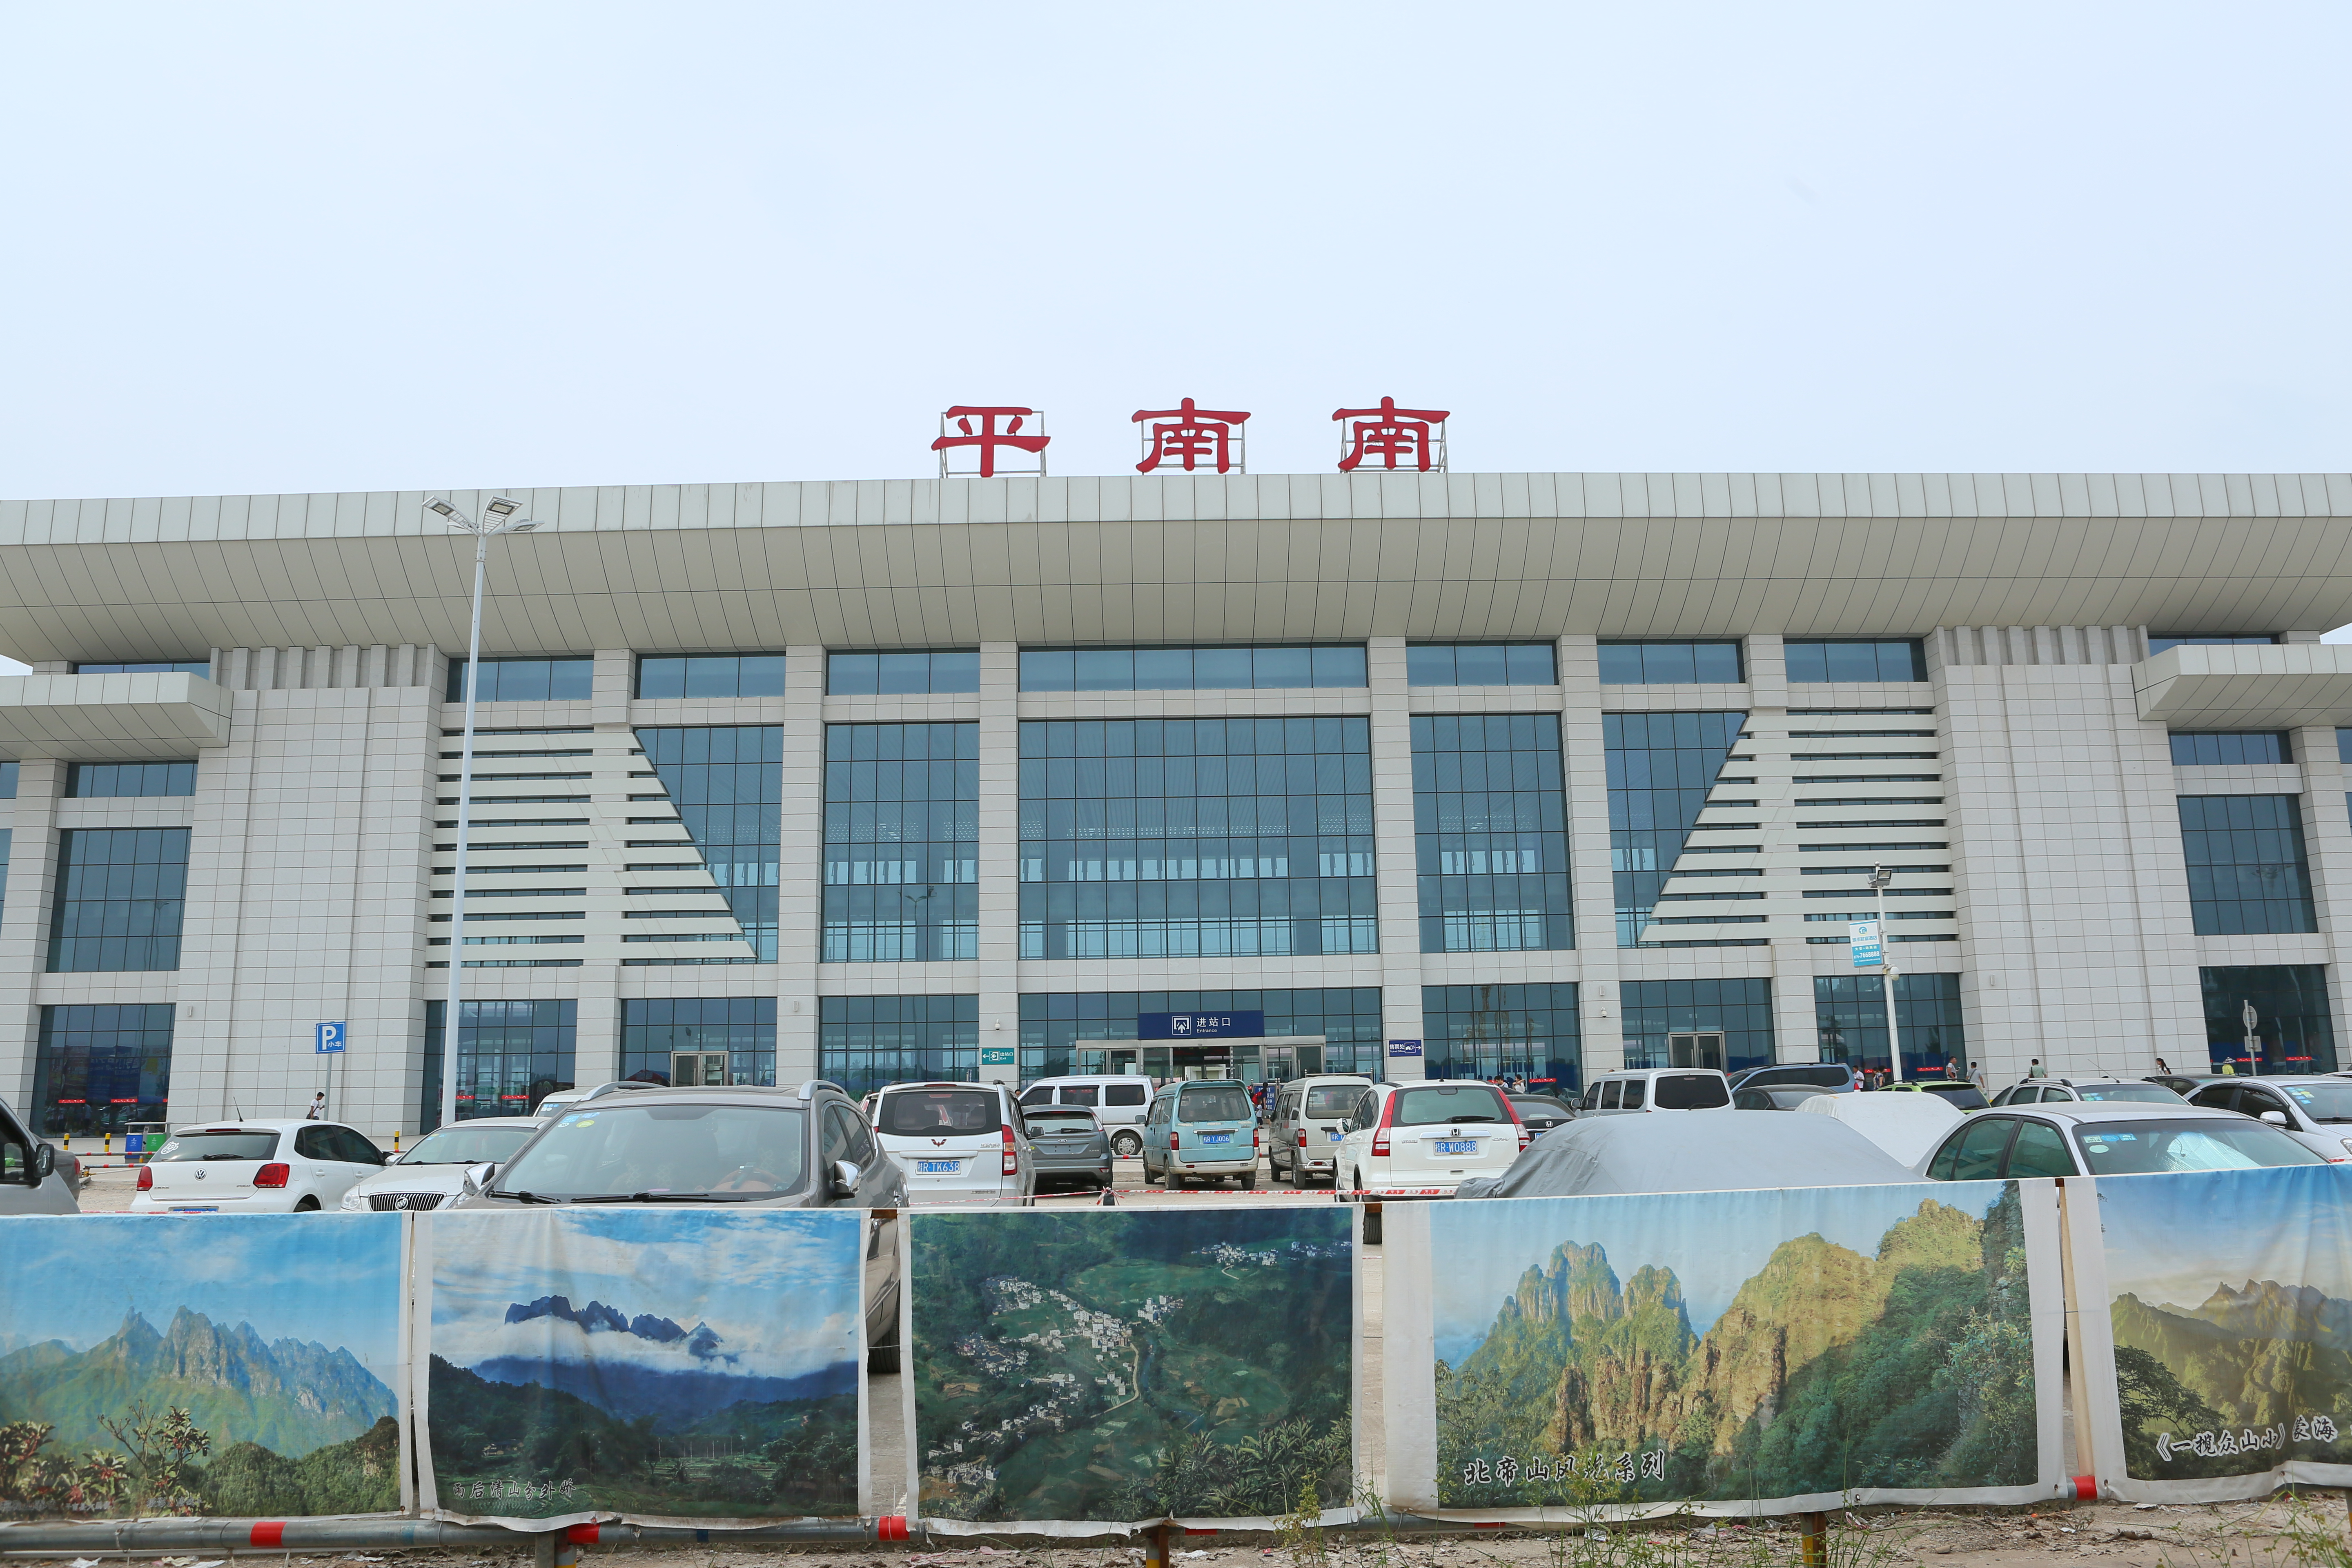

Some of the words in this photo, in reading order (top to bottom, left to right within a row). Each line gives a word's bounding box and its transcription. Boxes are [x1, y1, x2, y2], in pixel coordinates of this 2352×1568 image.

[931, 396, 1450, 478] 平南南
[1196, 1017, 1230, 1027] 进站口
[322, 1025, 336, 1050] P
[918, 1162, 959, 1172] 桂R·TK638
